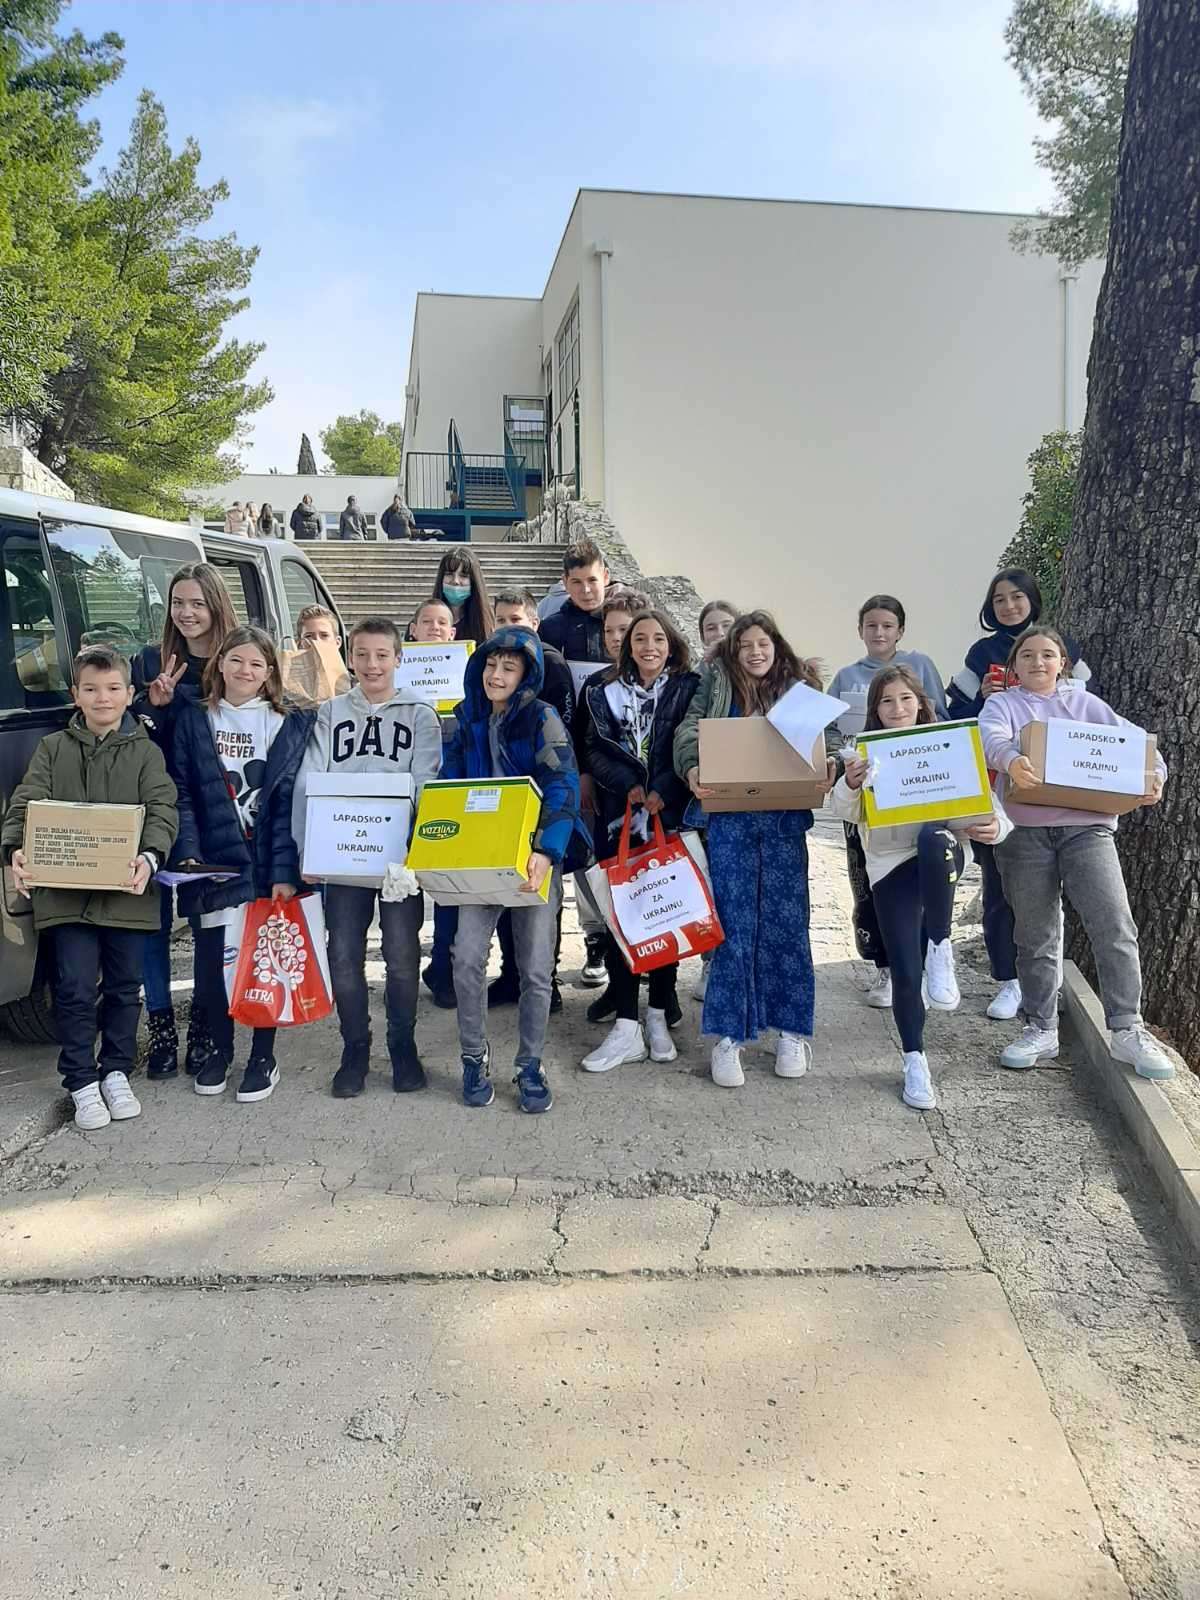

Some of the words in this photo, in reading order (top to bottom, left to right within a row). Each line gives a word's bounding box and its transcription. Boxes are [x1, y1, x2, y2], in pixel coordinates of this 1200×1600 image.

[403, 655, 443, 664] LAPADSKO
[411, 678, 449, 686] UKRAJINU
[216, 730, 253, 744] FRIENDS
[333, 716, 412, 763] GAP
[1068, 731, 1116, 744] LAPADSKO
[216, 742, 255, 758] OREVER
[890, 744, 940, 759] LAPADSKO
[1090, 748, 1102, 756] ZA
[916, 761, 929, 769] ZA
[1072, 760, 1118, 773] UKRAJINU
[901, 772, 950, 786] UKRAJINU
[333, 813, 382, 824] LAPADSKO
[355, 829, 367, 838] ZA
[337, 843, 383, 853] UKRAJINU
[629, 878, 669, 900] LAPADSKO
[652, 894, 664, 903] ZA
[643, 900, 683, 920] UKRAJINU
[636, 938, 668, 957] ULTRA
[244, 988, 274, 1004] ULTRA
